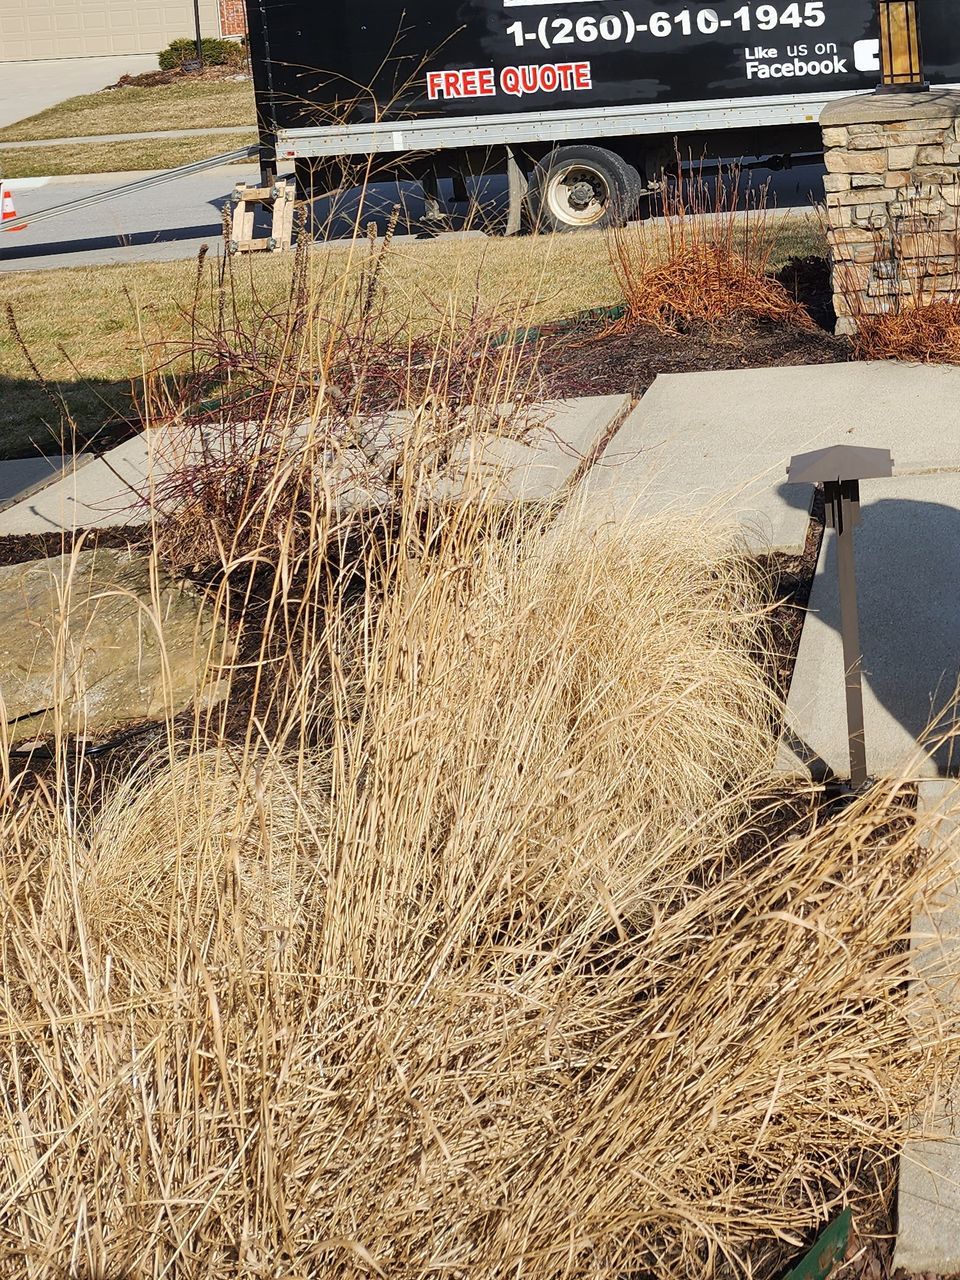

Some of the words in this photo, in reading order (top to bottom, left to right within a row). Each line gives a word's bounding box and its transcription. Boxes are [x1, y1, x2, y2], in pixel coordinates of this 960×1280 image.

[506, 1, 826, 49] 1-(260)-610-1945
[786, 43, 808, 57] us
[814, 42, 838, 55] on
[426, 67, 496, 101] FREE
[500, 61, 593, 98] QUOTE
[745, 55, 848, 80] Facebook
